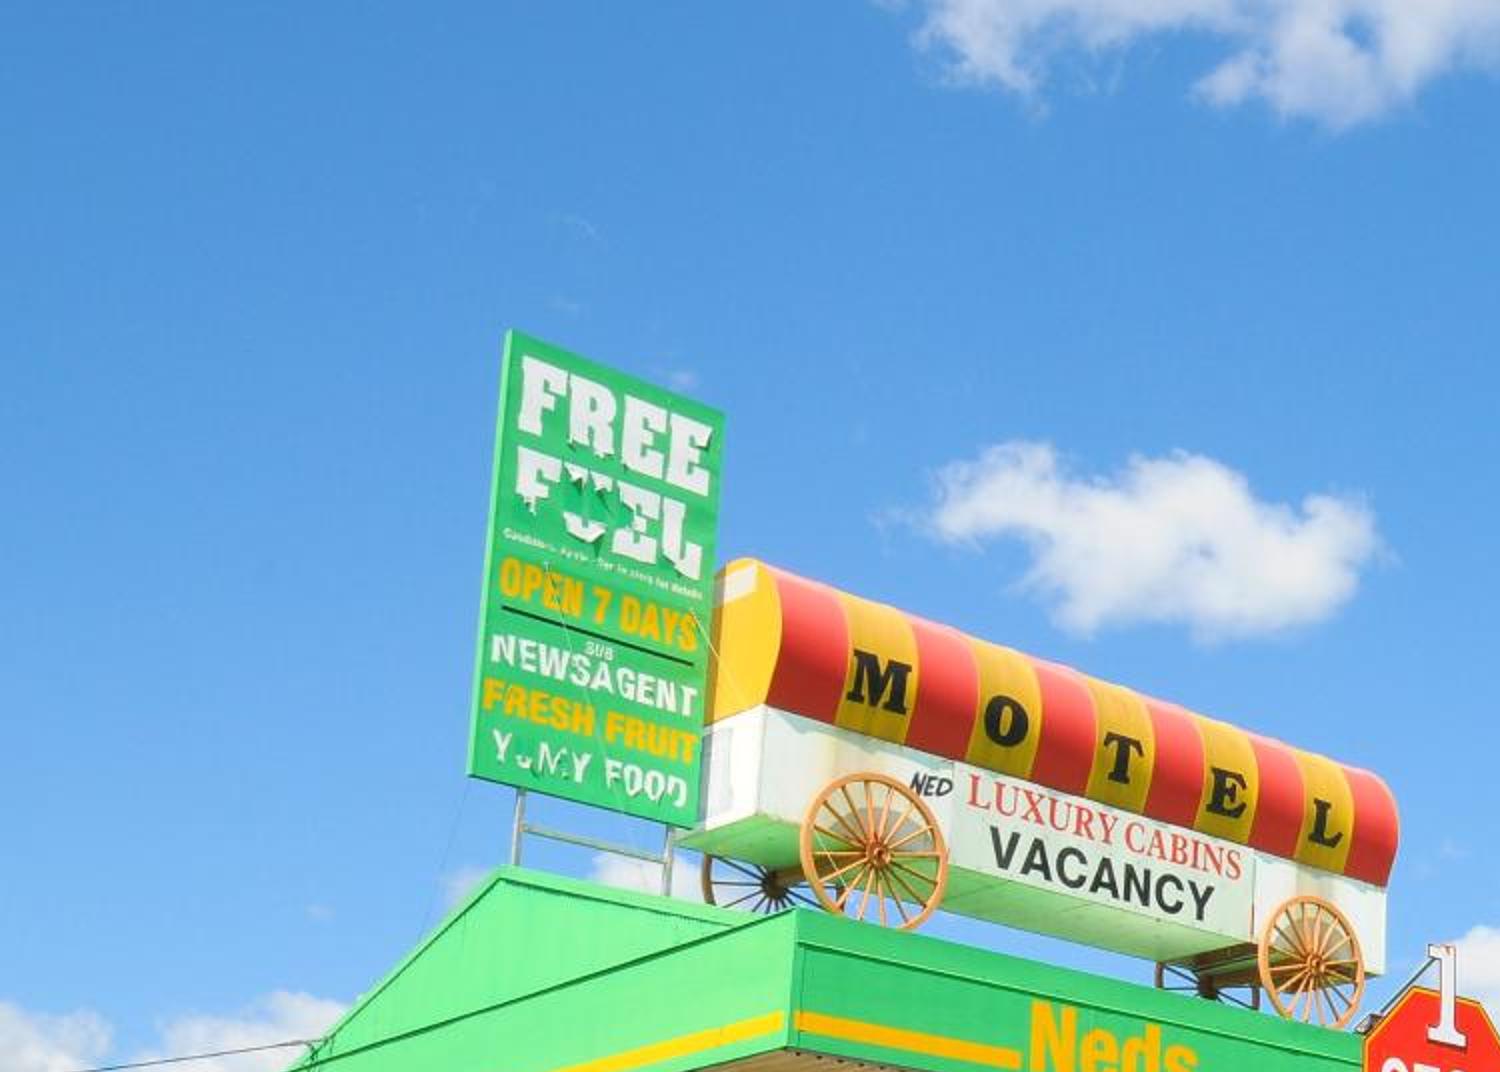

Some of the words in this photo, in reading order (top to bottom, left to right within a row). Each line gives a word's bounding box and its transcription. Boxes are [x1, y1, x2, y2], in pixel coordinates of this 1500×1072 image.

[518, 354, 713, 497] FREE
[501, 556, 584, 621] OPEN
[593, 585, 612, 625] 7
[620, 594, 697, 652] DAYS
[482, 677, 595, 736] FRESH
[605, 710, 697, 765] FRUIT
[491, 634, 698, 717] NEWSAGENT
[909, 771, 953, 798] NED
[967, 773, 1119, 845] LUXURY
[1125, 820, 1243, 882] CABINS
[989, 825, 1215, 922] VACANCY
